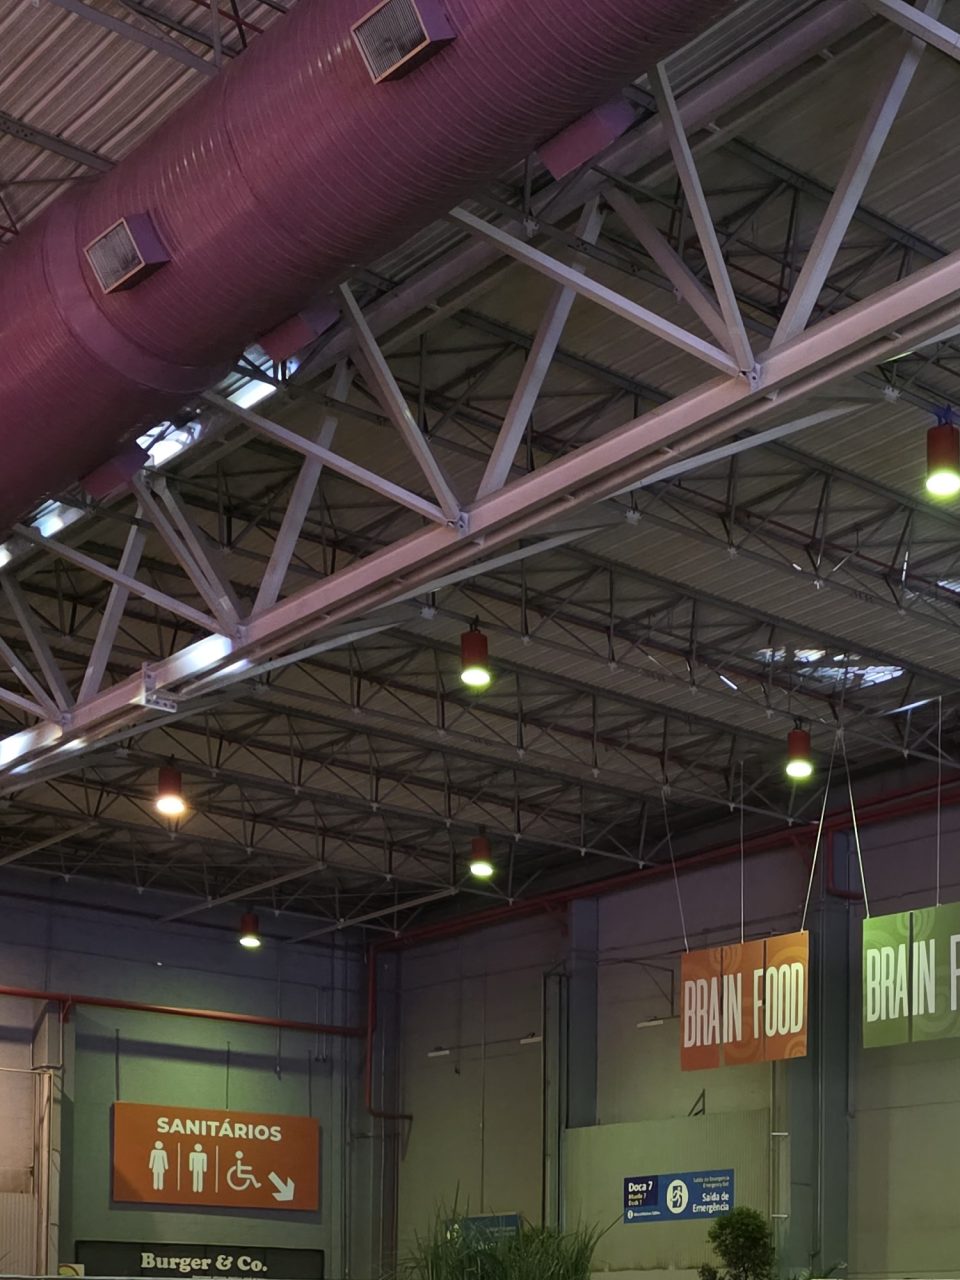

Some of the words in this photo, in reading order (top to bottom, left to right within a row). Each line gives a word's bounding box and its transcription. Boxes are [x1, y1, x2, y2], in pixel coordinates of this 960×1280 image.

[866, 939, 936, 1023] BRAIN
[684, 973, 742, 1048] BRAIN
[753, 962, 804, 1039] FOOD
[157, 1117, 282, 1142] SANITÁRIOS
[628, 1182, 647, 1193] Doca
[648, 1180, 653, 1191] 7
[720, 1191, 730, 1201] de
[692, 1202, 730, 1214] Emergência
[141, 1252, 212, 1273] Burger
[215, 1254, 233, 1271] &
[237, 1256, 268, 1272] Co.
